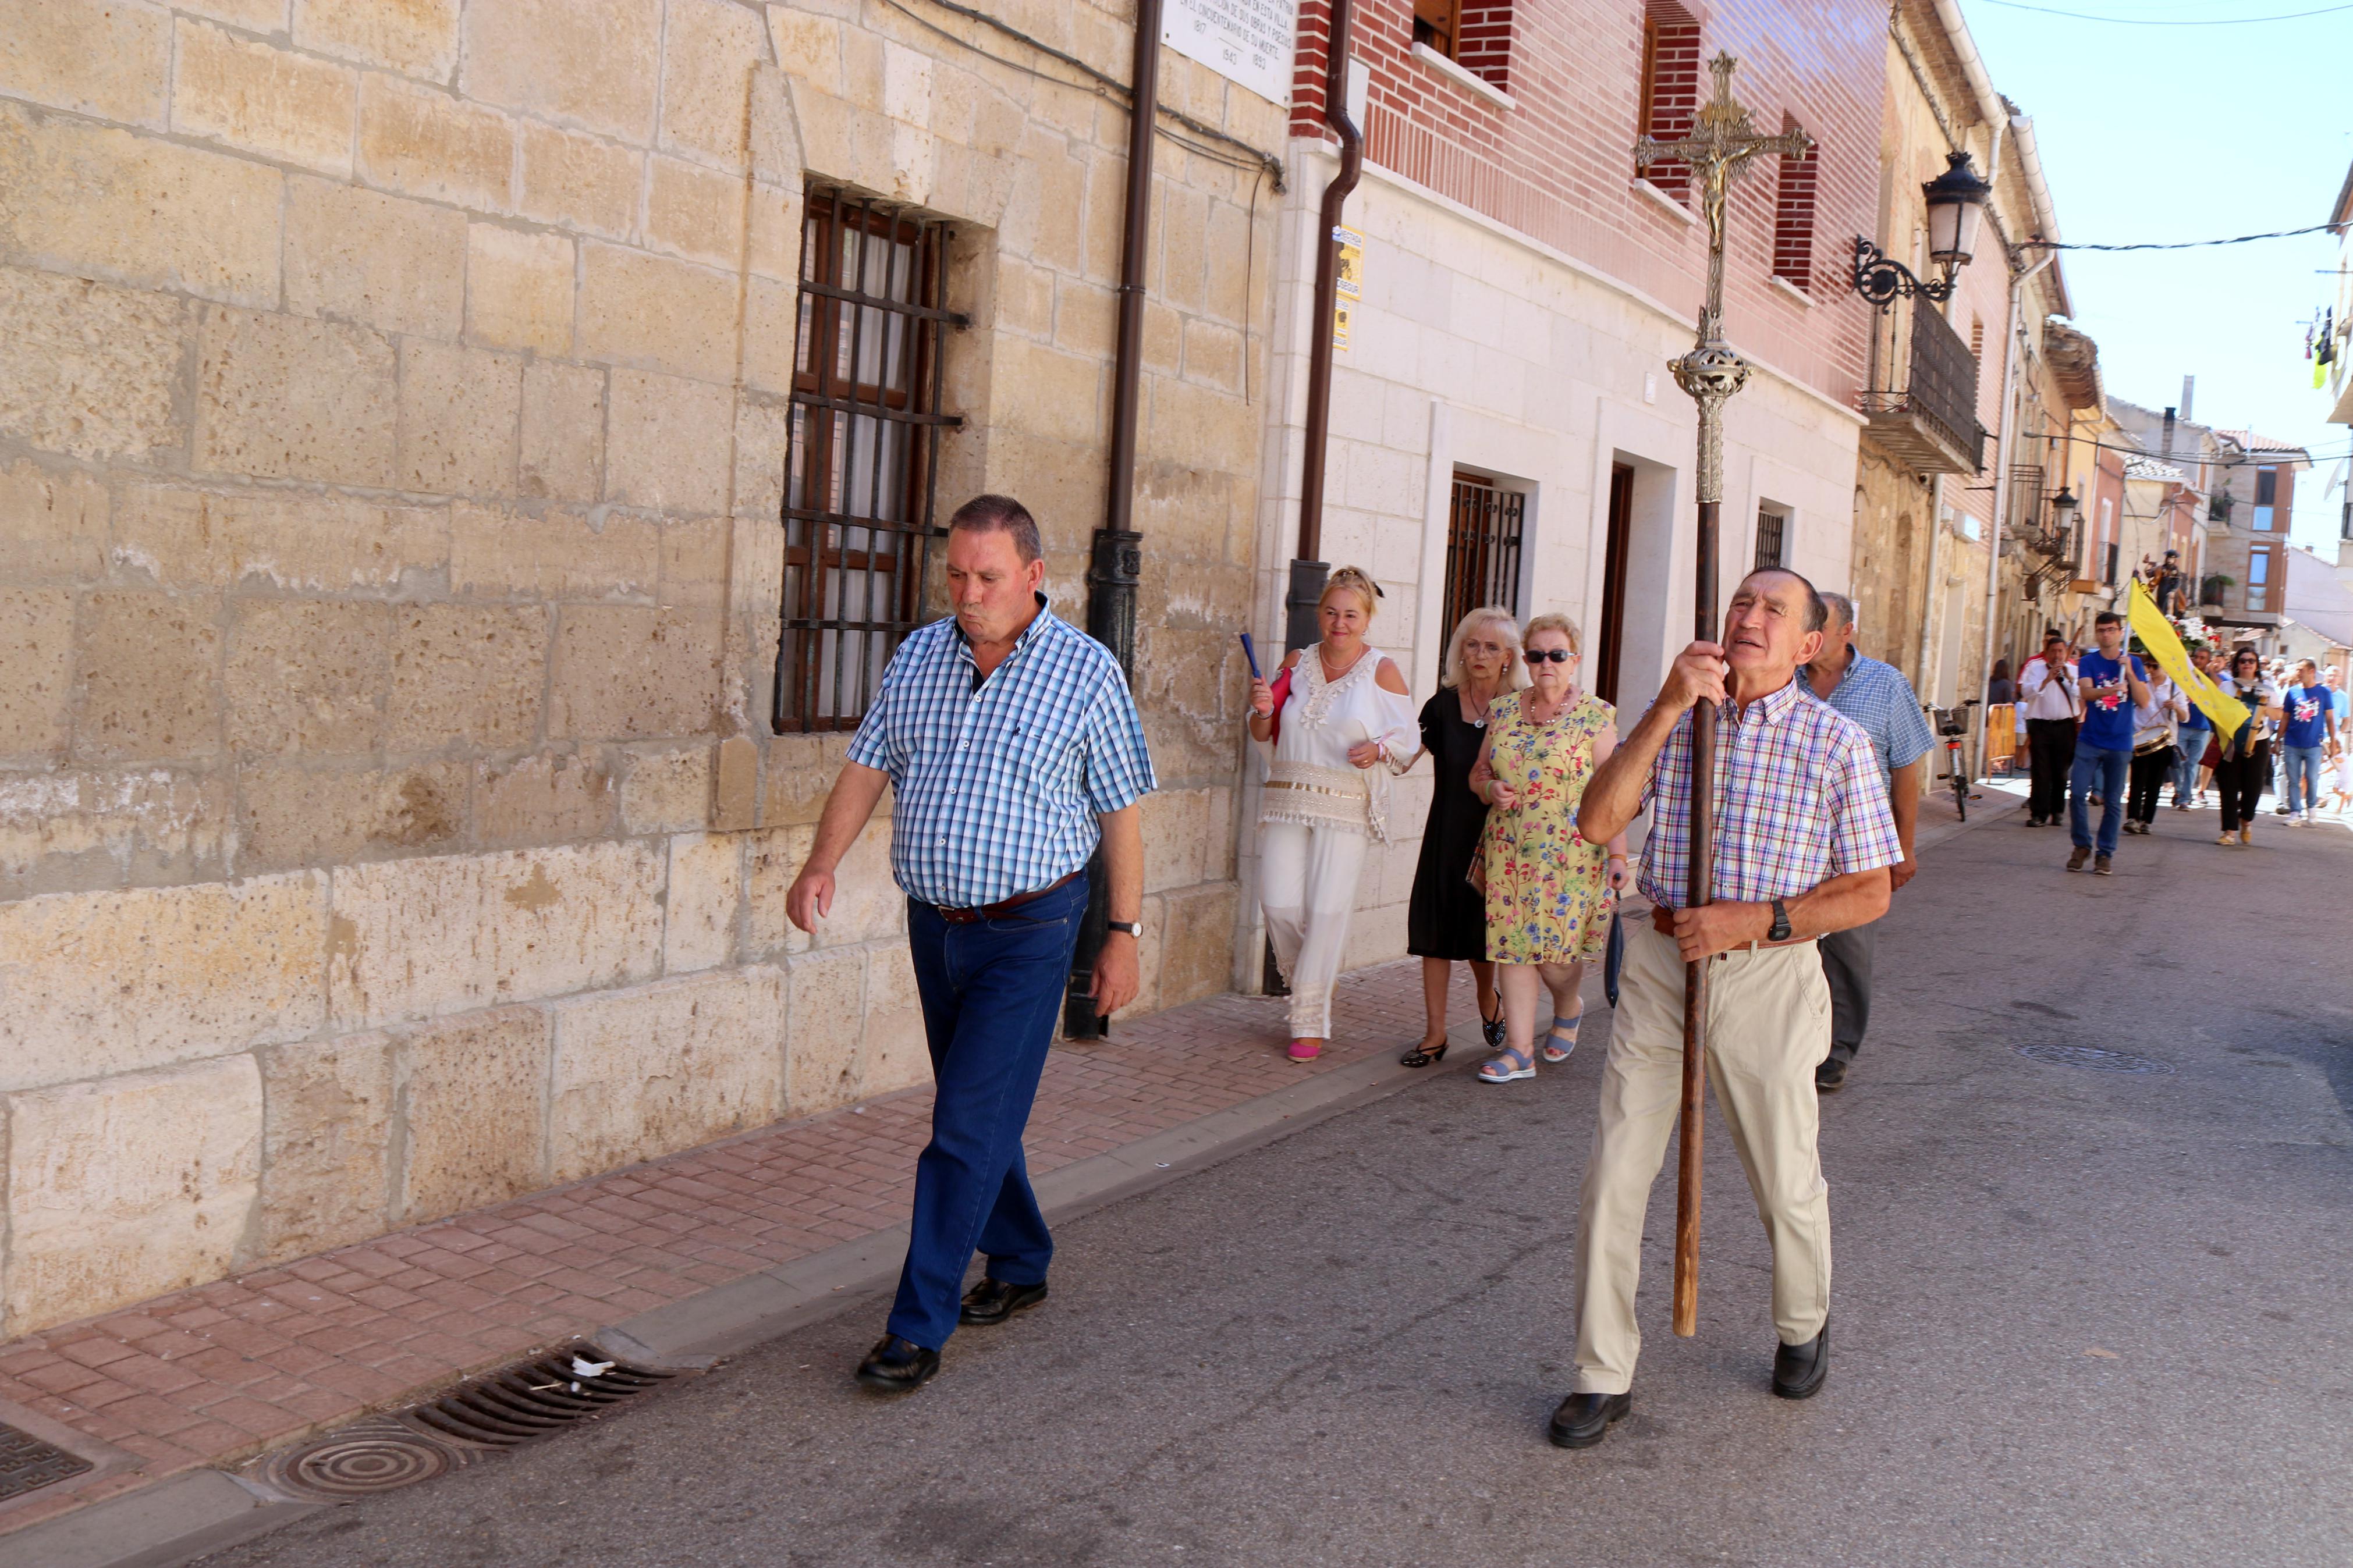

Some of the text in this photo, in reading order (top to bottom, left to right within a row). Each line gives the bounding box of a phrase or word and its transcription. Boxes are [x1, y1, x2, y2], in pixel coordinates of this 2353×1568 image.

[1230, 3, 1237, 17] DE
[1251, 16, 1266, 34] OBRAS
[1260, 3, 1273, 20] ESTA
